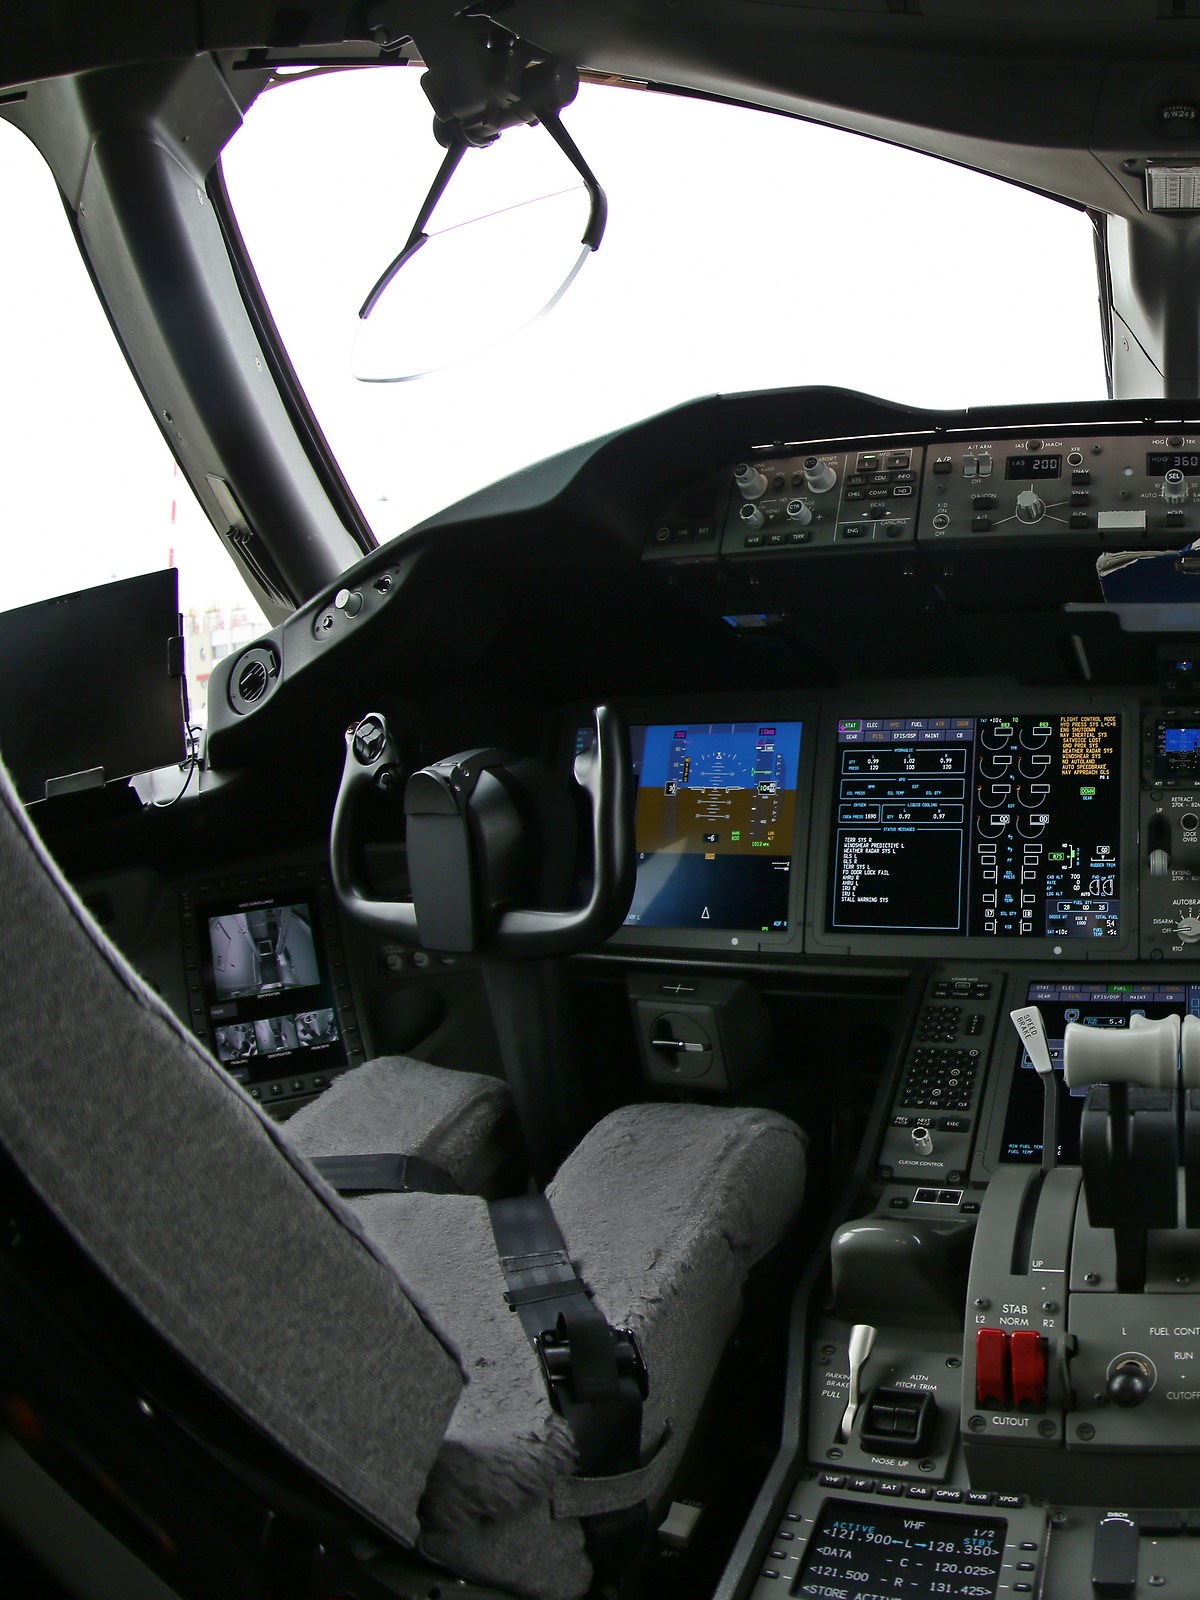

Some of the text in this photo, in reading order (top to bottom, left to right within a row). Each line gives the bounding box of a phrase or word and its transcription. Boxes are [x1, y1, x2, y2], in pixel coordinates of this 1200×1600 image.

[1033, 460, 1058, 469] 200
[1174, 456, 1198, 466] 360
[1016, 1016, 1032, 1039] BRAKE
[1023, 1014, 1038, 1036] SPEED
[1032, 1260, 1043, 1268] UP
[1002, 1304, 1028, 1315] STAB
[975, 1315, 985, 1324] L2
[1000, 1317, 1029, 1326] NORM
[1043, 1319, 1055, 1327] R2
[1149, 1328, 1169, 1336] FUEL
[1174, 1351, 1194, 1360] RUN
[825, 1372, 850, 1380] PARKIN
[826, 1380, 850, 1389] BRAKE
[821, 1390, 840, 1399] PULL
[1166, 1391, 1200, 1400] CUTOFF
[992, 1416, 1029, 1427] CUTOUT
[871, 1457, 895, 1465] NOSE
[881, 1483, 897, 1491] SAT
[910, 1487, 926, 1495] CAB
[936, 1490, 960, 1498] GPWS
[833, 1521, 875, 1533] ACTIVE
[904, 1520, 926, 1530] VHF
[974, 1529, 995, 1538] 1/2
[904, 1539, 912, 1548] L
[963, 1538, 994, 1547] STBY
[900, 1558, 909, 1567] C
[894, 1578, 904, 1587] R
